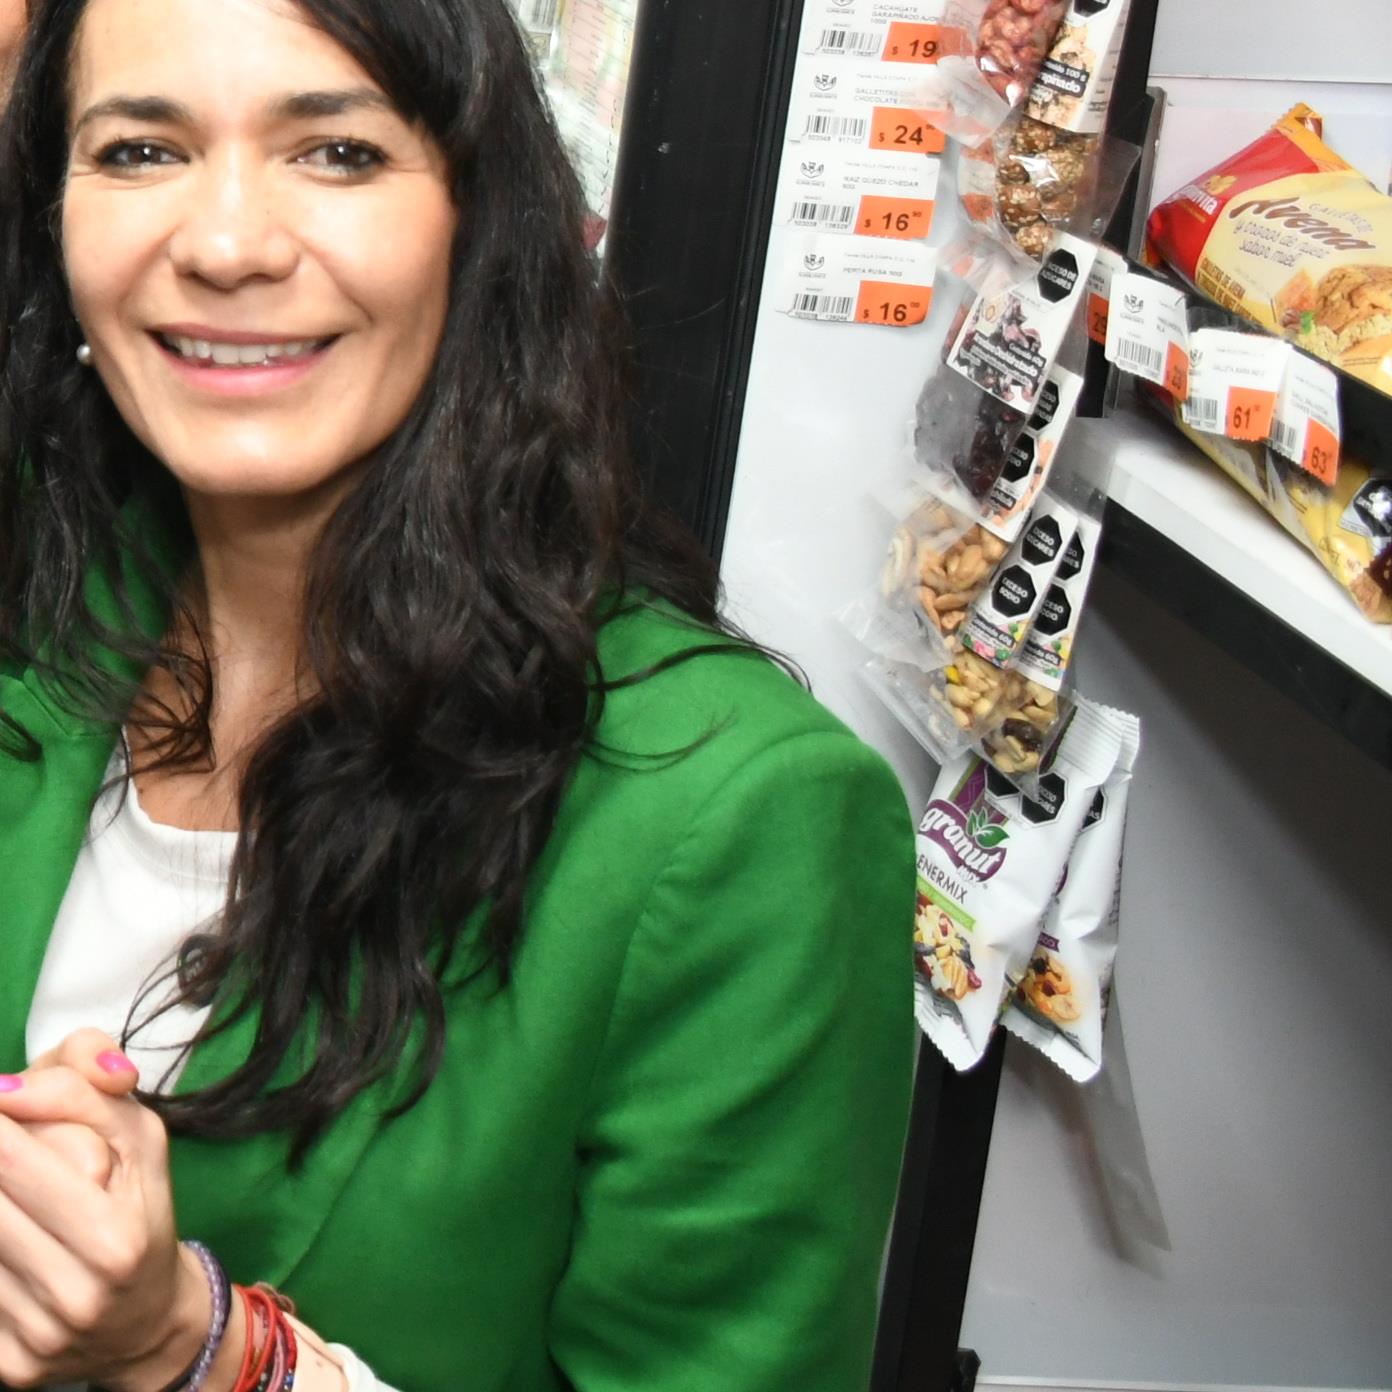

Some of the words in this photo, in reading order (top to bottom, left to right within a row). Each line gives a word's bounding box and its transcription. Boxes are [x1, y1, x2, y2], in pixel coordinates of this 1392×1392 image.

[909, 39, 938, 58] 19
[894, 124, 924, 146] 24
[882, 211, 910, 232] 16
[879, 301, 908, 323] 16
[1233, 404, 1251, 429] 61
[1310, 446, 1327, 475] 63
[919, 807, 1002, 875] granut
[917, 853, 968, 906] ENERMIX
